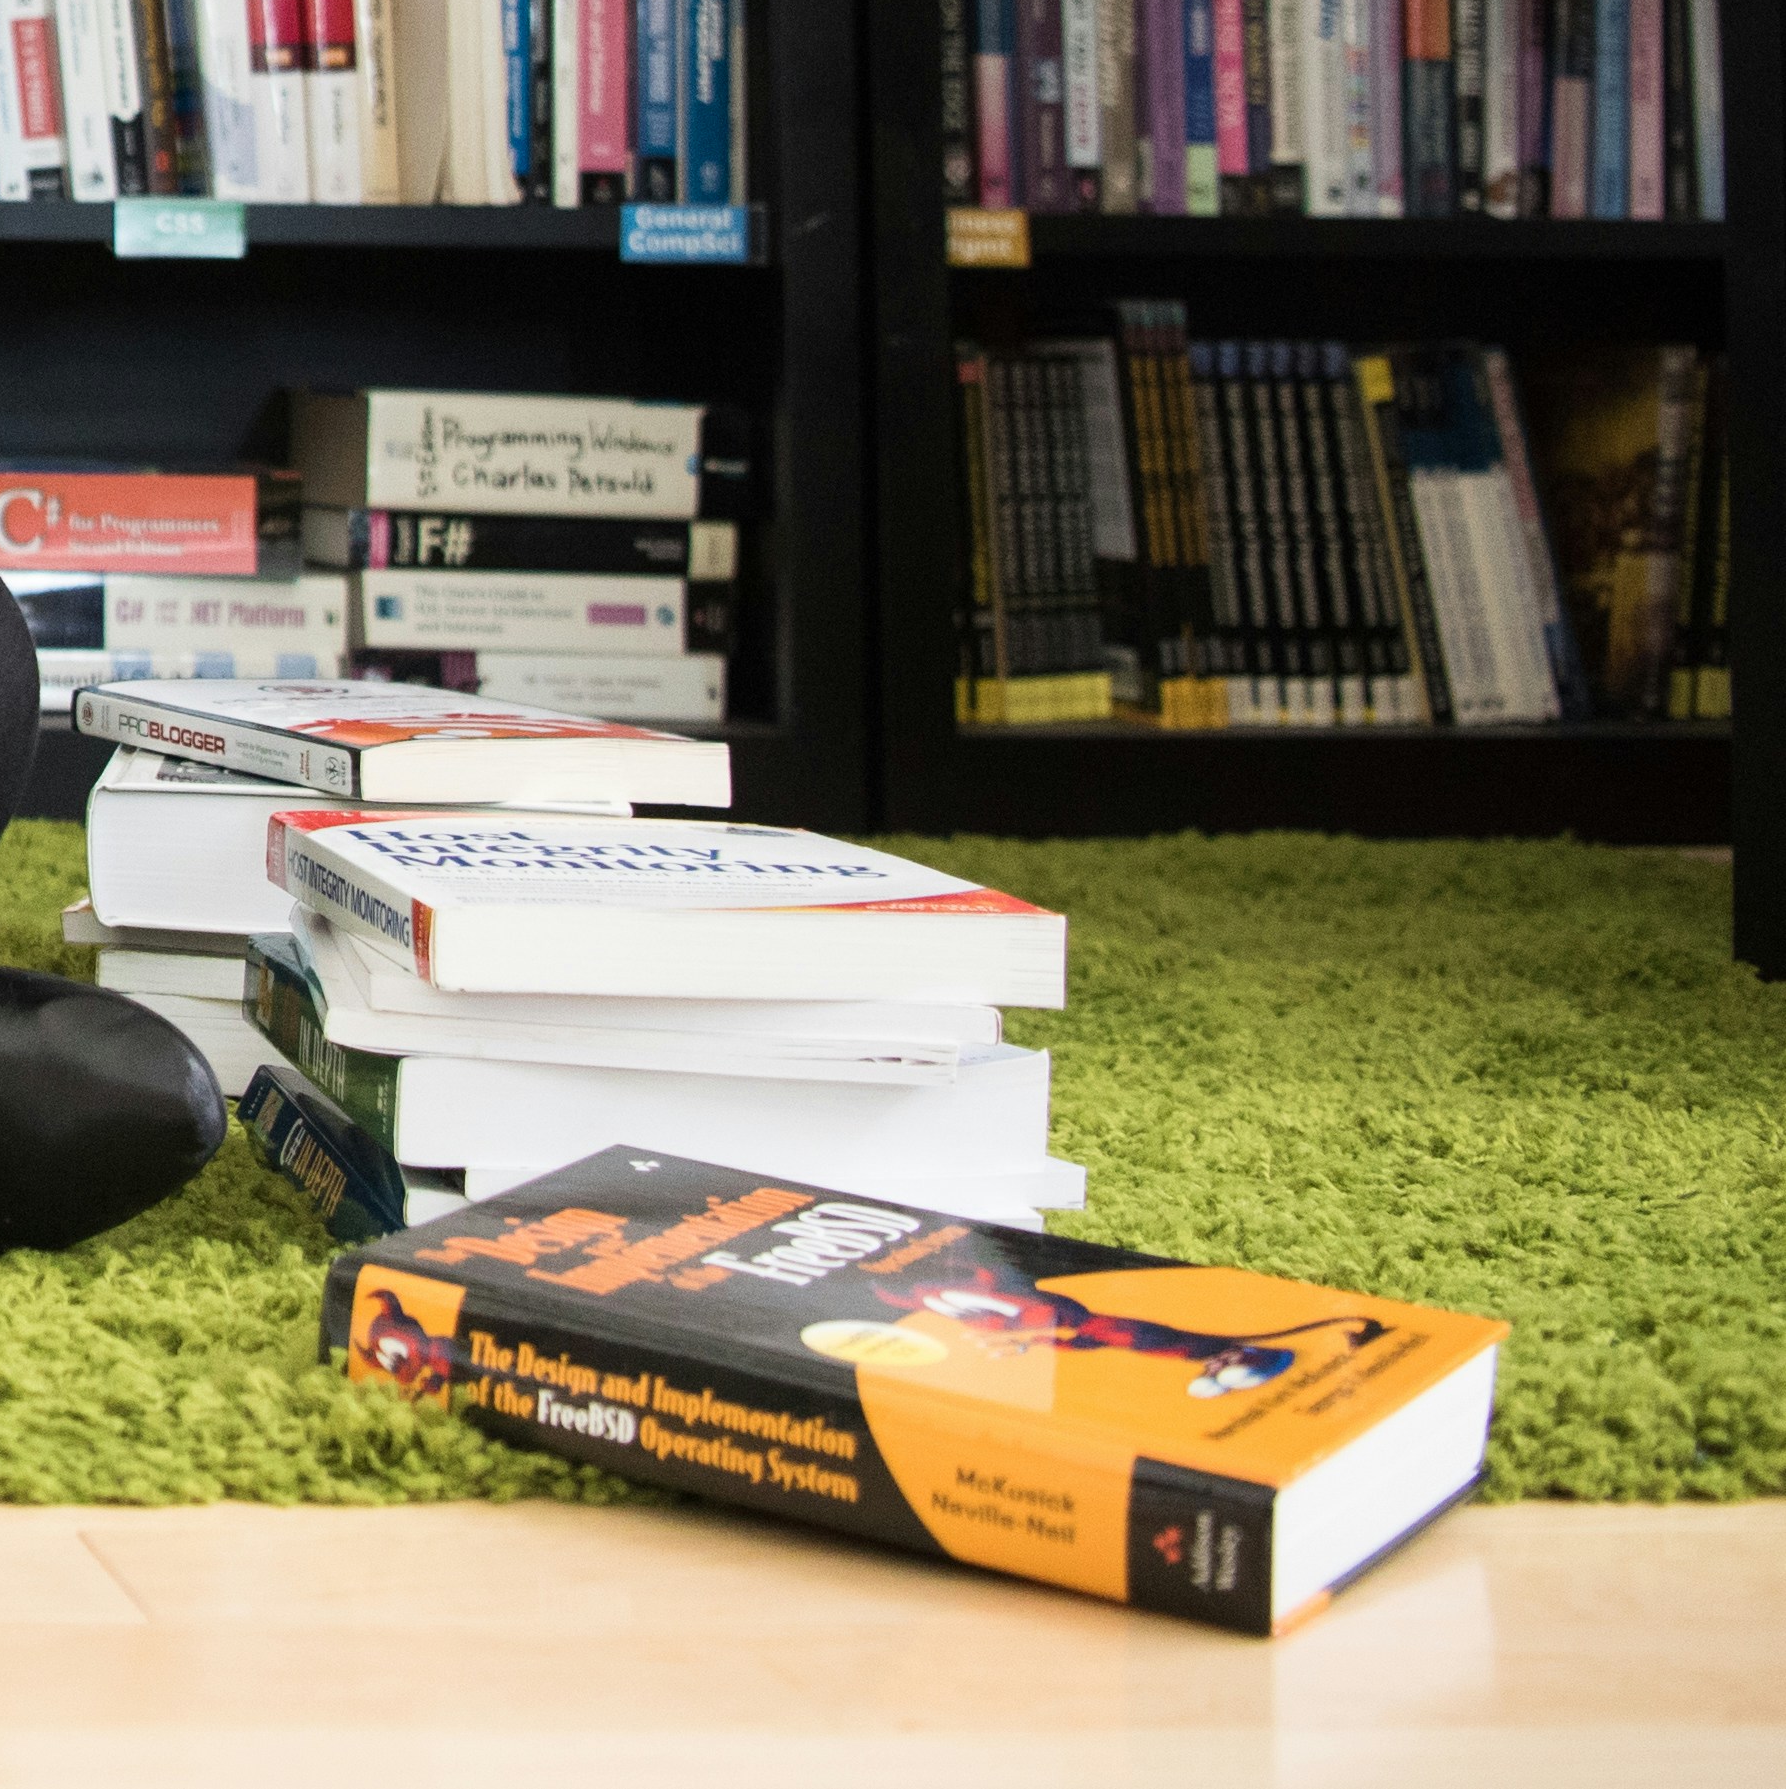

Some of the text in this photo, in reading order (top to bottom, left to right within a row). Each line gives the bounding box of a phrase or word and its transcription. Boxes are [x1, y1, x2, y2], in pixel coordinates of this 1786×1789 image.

[155, 213, 206, 235] CSS
[636, 208, 733, 230] General
[629, 231, 743, 256] CompSci
[441, 416, 583, 462] Programming
[452, 463, 557, 493] Charles
[100, 512, 220, 536] Programmers
[418, 517, 475, 566] F#
[229, 599, 306, 628] Platform
[118, 712, 226, 757] PROBLOGGER
[345, 827, 546, 844] Host
[359, 838, 728, 861] Integrity
[391, 852, 891, 880] Monitoring
[287, 845, 411, 949] HOST INTEGRITY MONITORING
[304, 1147, 348, 1218] DEPTH
[699, 1201, 921, 1288] FreeBSD
[469, 1330, 858, 1462] The Design and Implementation
[493, 1382, 859, 1504] the FreeBSD Operating System
[954, 1466, 1077, 1514] McKusick
[930, 1492, 1077, 1546] Neville-Neil
